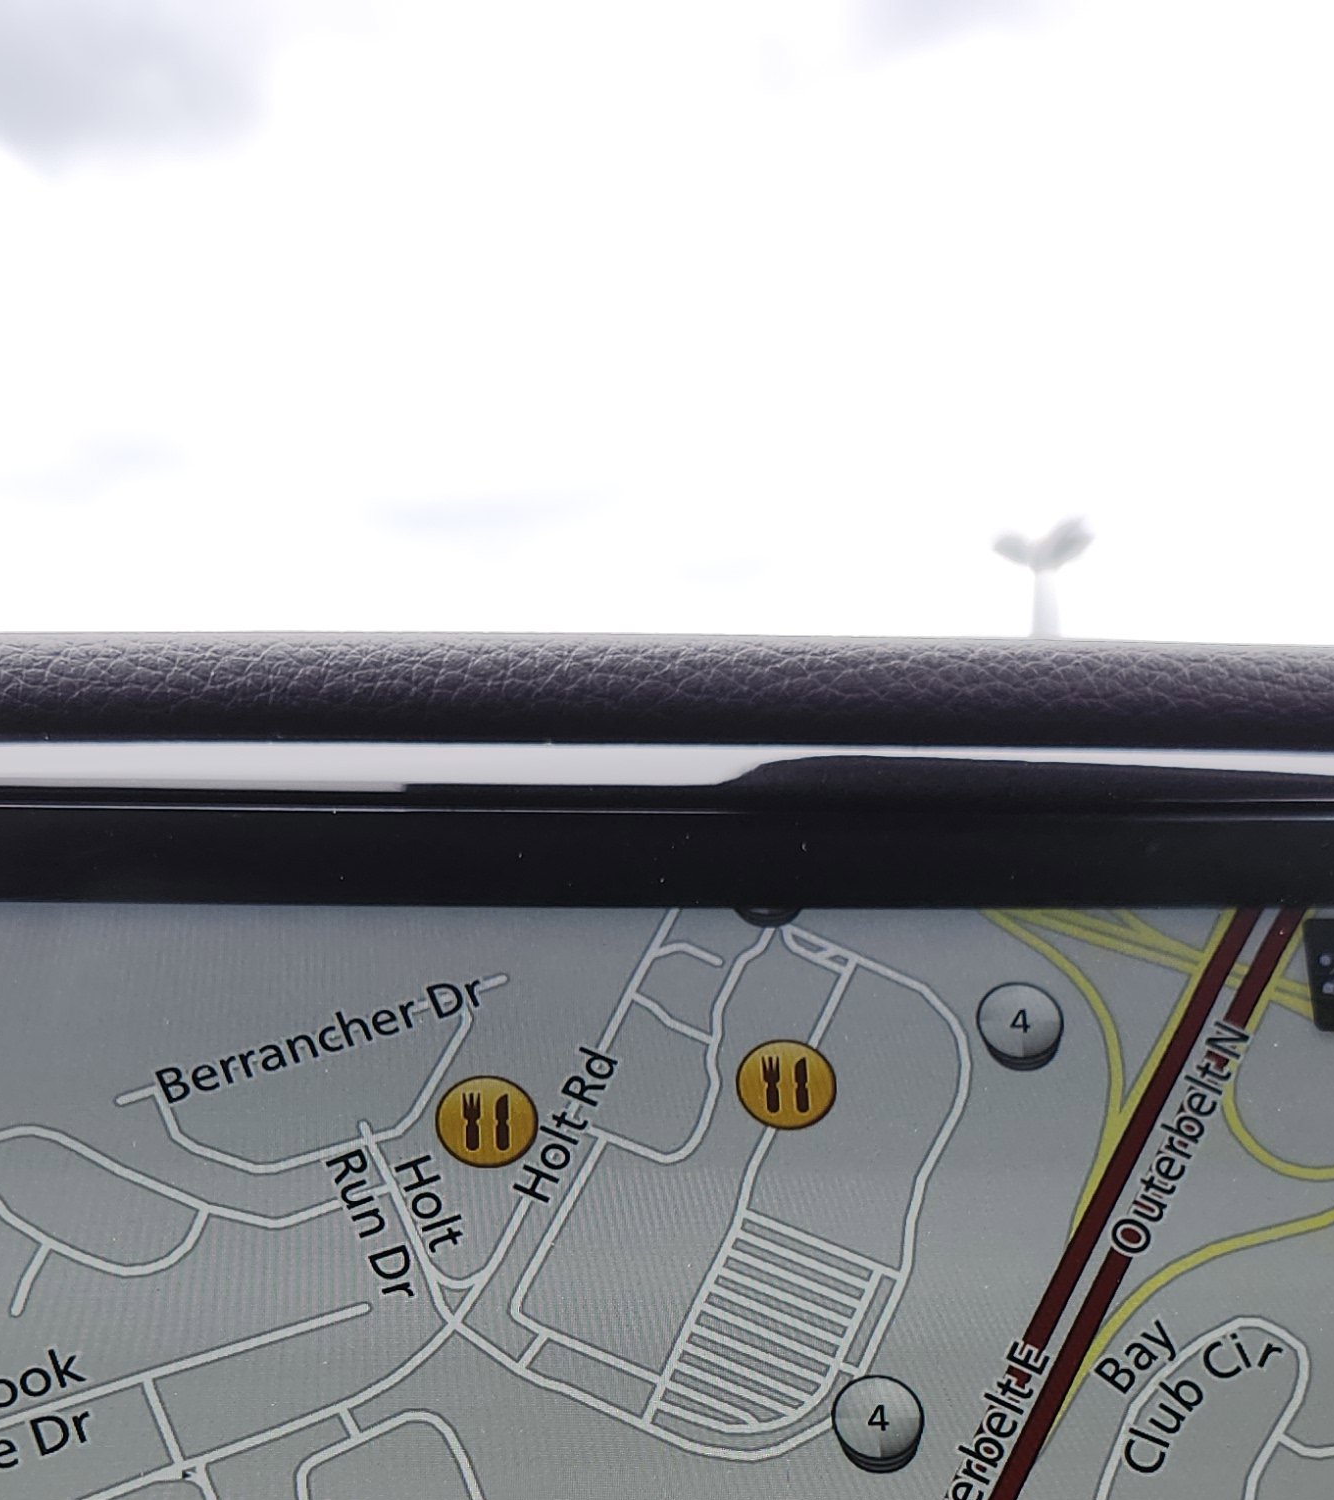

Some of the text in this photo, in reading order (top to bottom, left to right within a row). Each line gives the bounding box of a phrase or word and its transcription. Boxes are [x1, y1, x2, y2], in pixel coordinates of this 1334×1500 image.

[155, 976, 482, 1103] Berrancher Dr
[1011, 1010, 1030, 1033] 4
[514, 1046, 618, 1202] Holt Rd
[1112, 1021, 1250, 1254] Outerbelt N
[326, 1149, 415, 1299] Run Dr
[395, 1154, 461, 1253] Holt
[1006, 1341, 1050, 1376] E
[1094, 1319, 1179, 1394] Bay
[1124, 1333, 1283, 1475] Club Cir
[31, 1408, 91, 1457] Dr
[867, 1408, 889, 1431] 4
